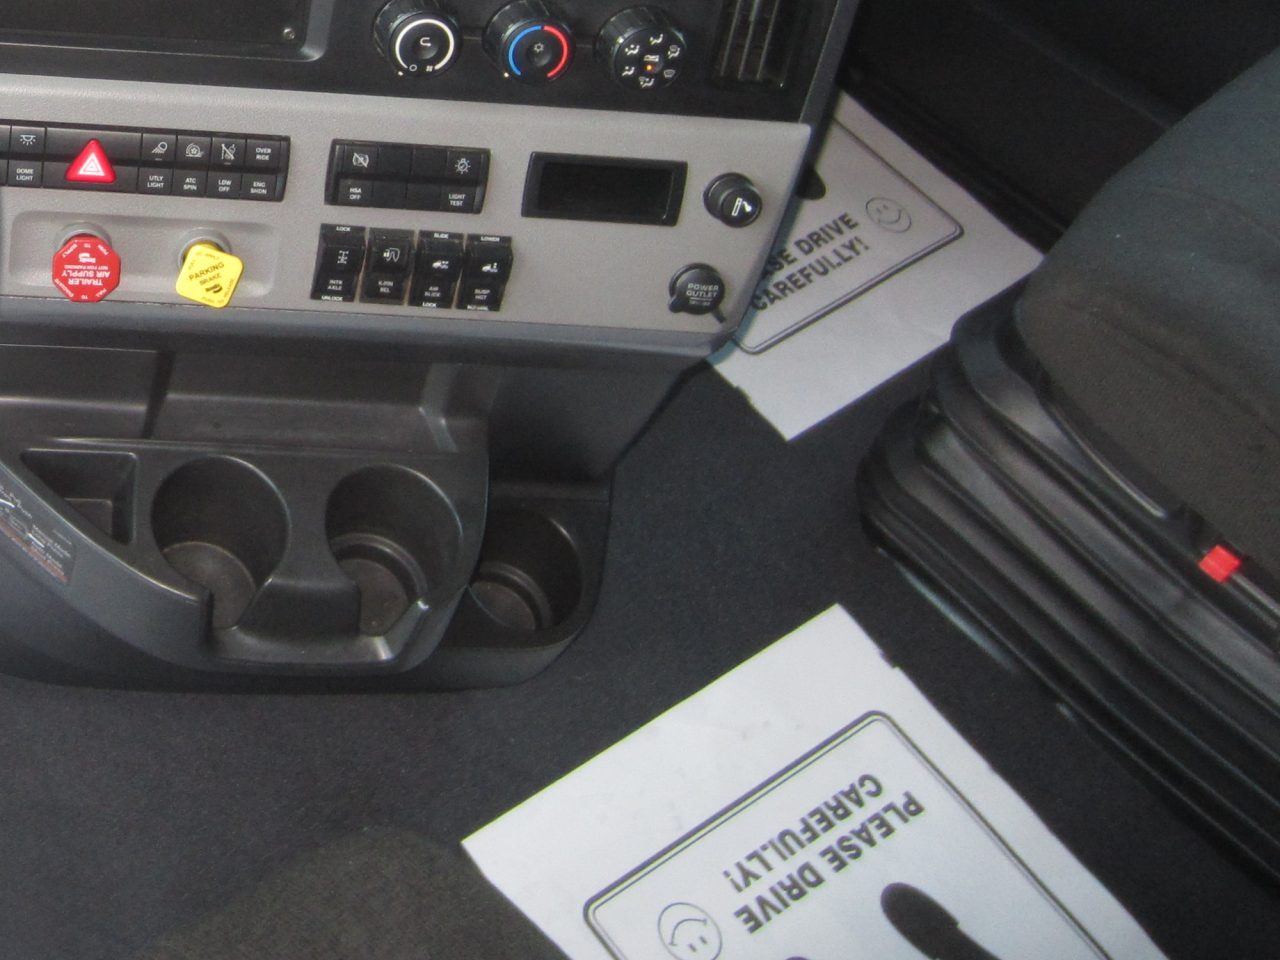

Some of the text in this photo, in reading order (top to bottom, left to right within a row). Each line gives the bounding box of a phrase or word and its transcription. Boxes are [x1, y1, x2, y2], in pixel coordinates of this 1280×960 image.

[794, 211, 859, 255] DRIVE
[68, 278, 103, 286] TRAILER
[189, 261, 225, 280] PARKING
[200, 273, 222, 285] BRAKE
[751, 236, 870, 311] CAREFULLY!
[688, 283, 719, 291] POWER
[722, 773, 885, 894] CAREFULLY!
[733, 790, 925, 934] PLEASE DRIVE
